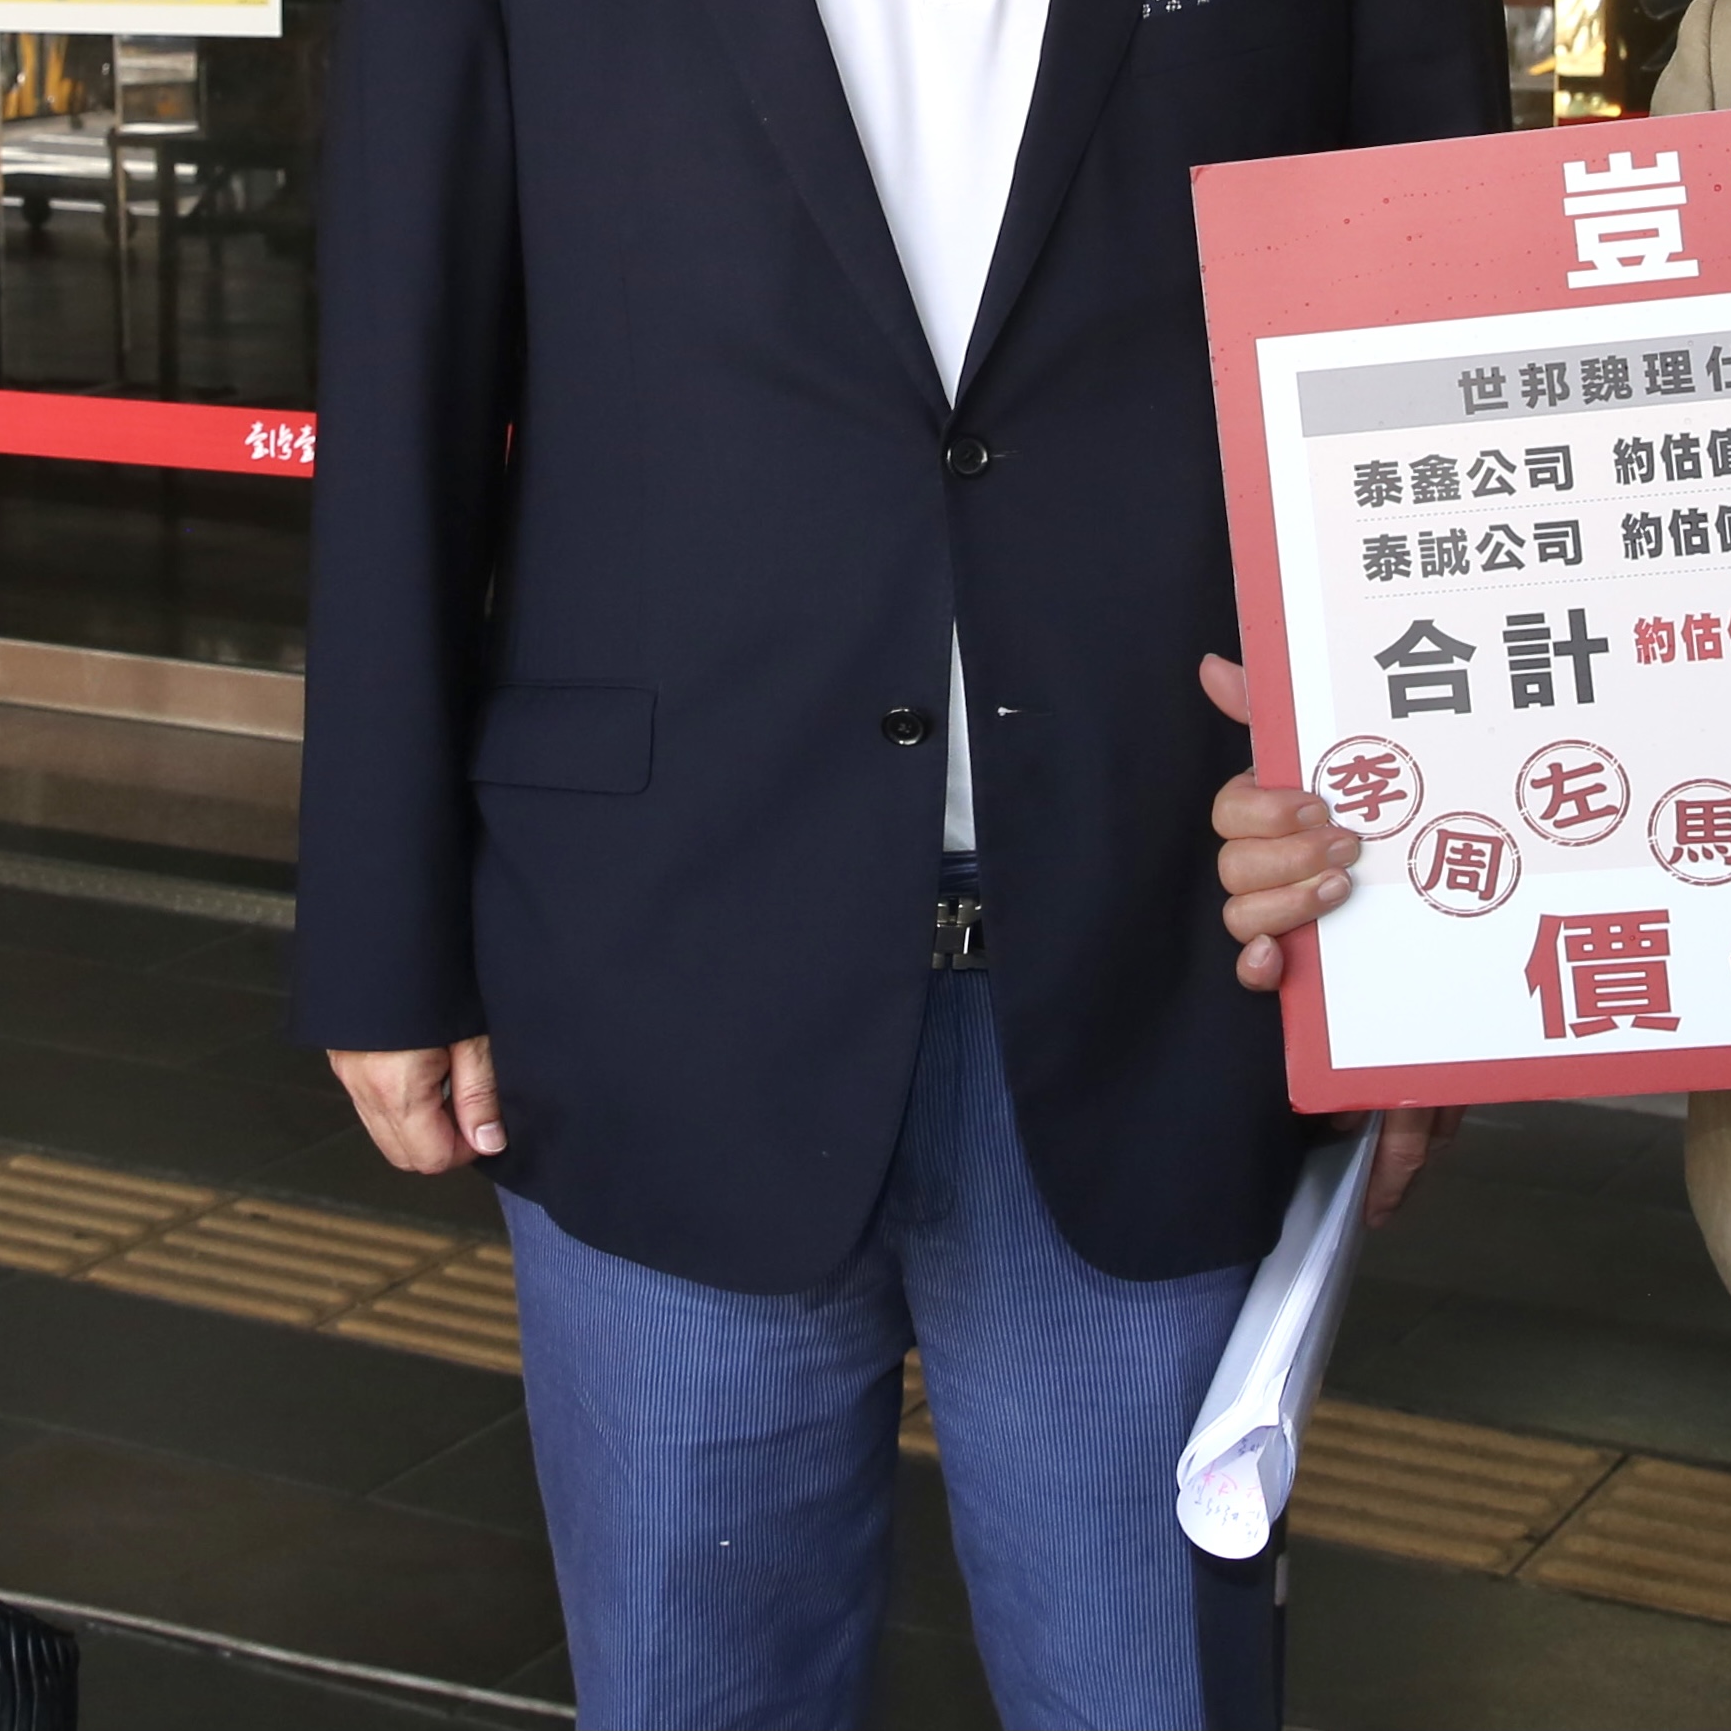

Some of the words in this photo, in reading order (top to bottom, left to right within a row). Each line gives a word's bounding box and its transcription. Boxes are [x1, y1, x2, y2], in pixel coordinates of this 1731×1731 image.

[1353, 443, 1575, 509] 泰鑫公司
[1362, 518, 1584, 583] 泰誠公司
[1373, 607, 1611, 720] 合計
[1326, 751, 1409, 824] 李
[1529, 761, 1620, 830] 左
[1424, 827, 1507, 902] 周
